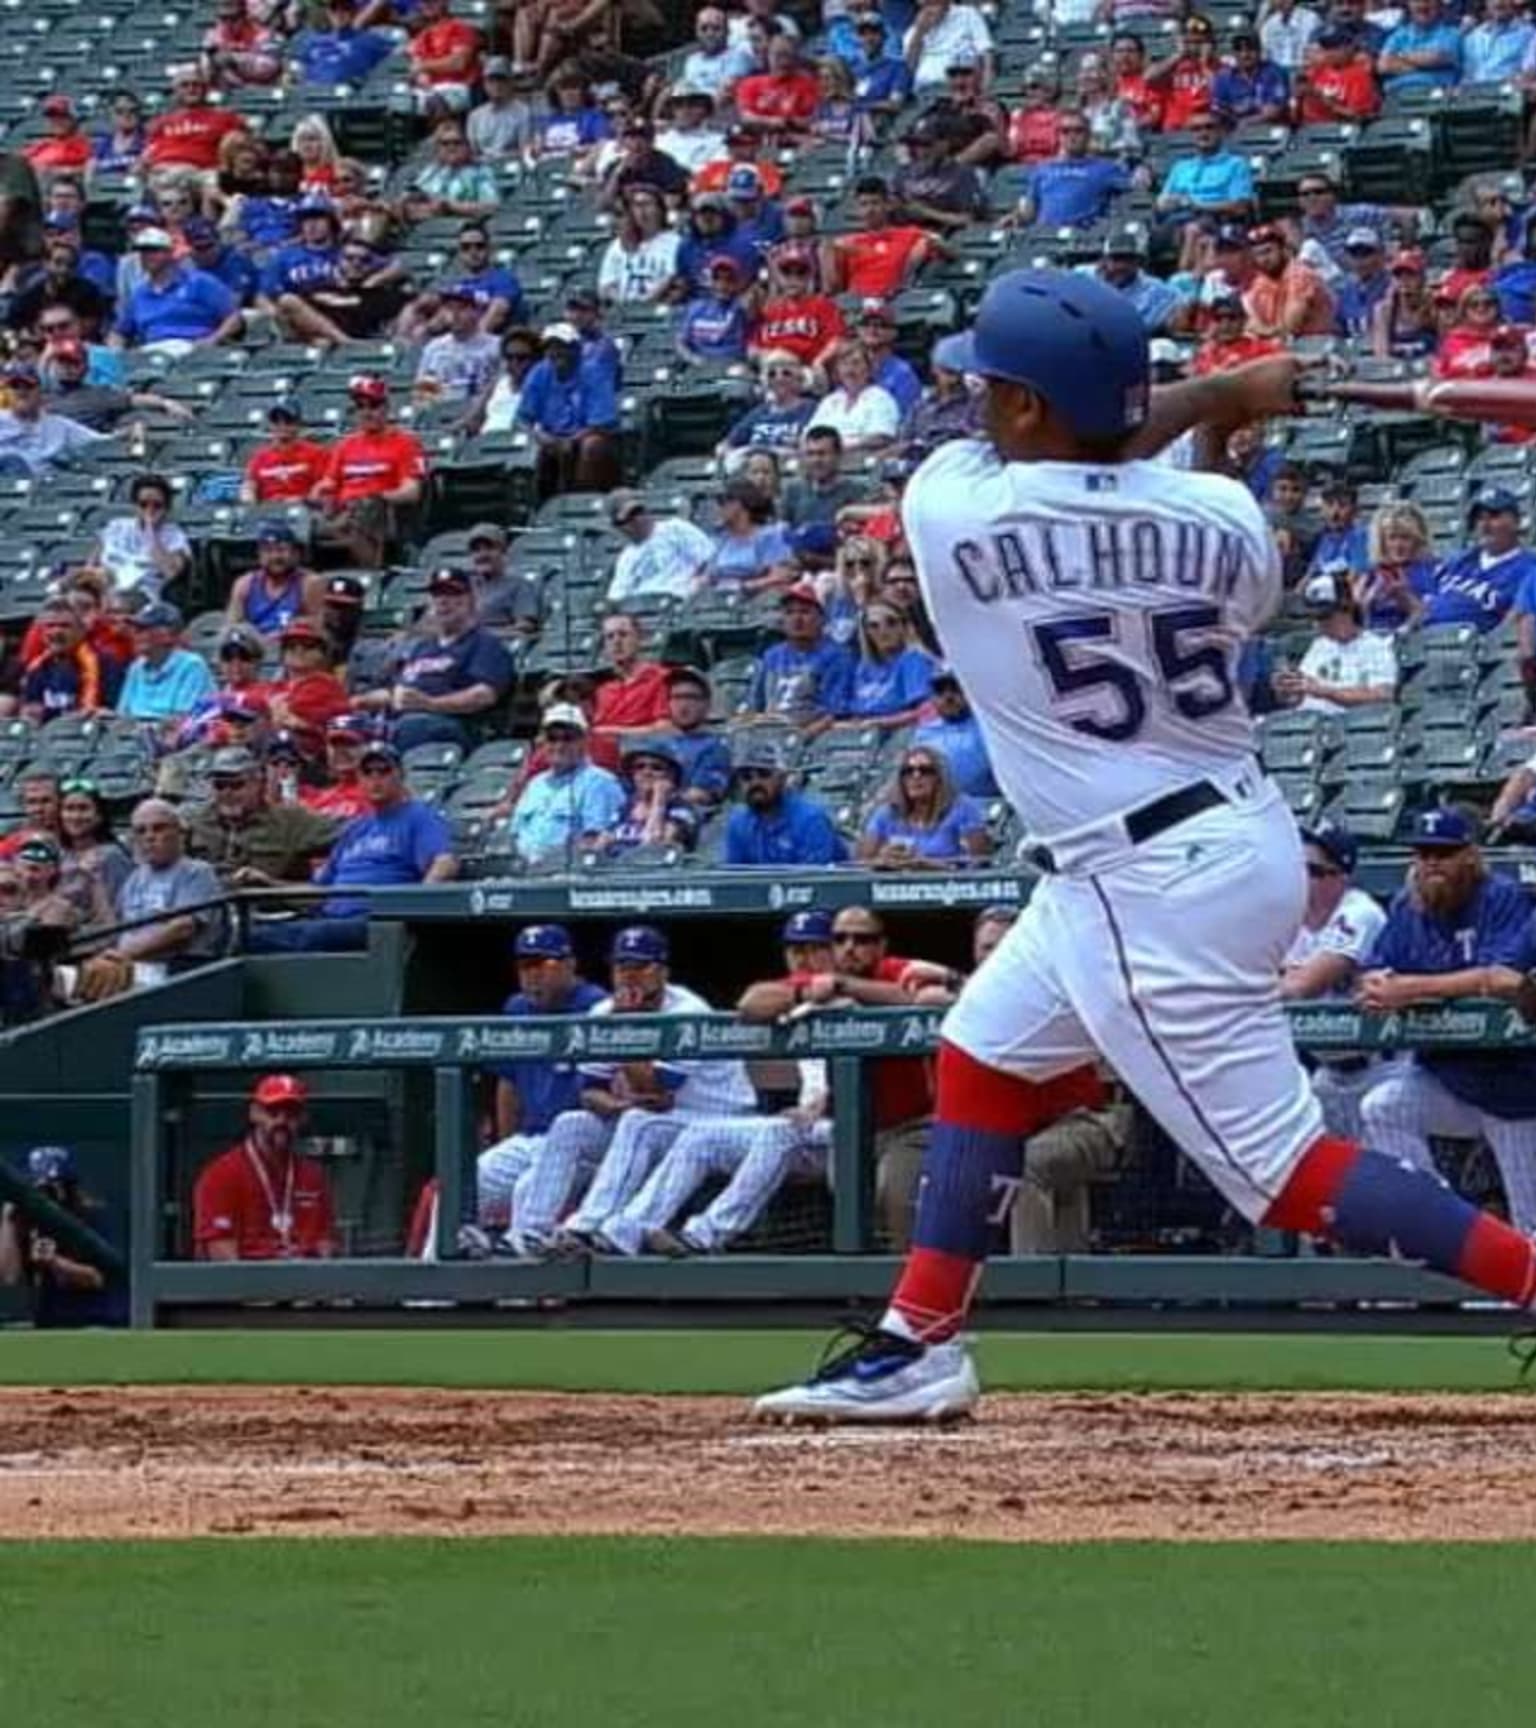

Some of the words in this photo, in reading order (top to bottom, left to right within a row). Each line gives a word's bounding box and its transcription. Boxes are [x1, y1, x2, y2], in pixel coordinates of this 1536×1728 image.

[952, 520, 1244, 604] CALHOUN
[1024, 601, 1235, 742] 55
[1453, 930, 1477, 961] T
[1295, 1012, 1361, 1040] cademy
[985, 1172, 1023, 1223] T
